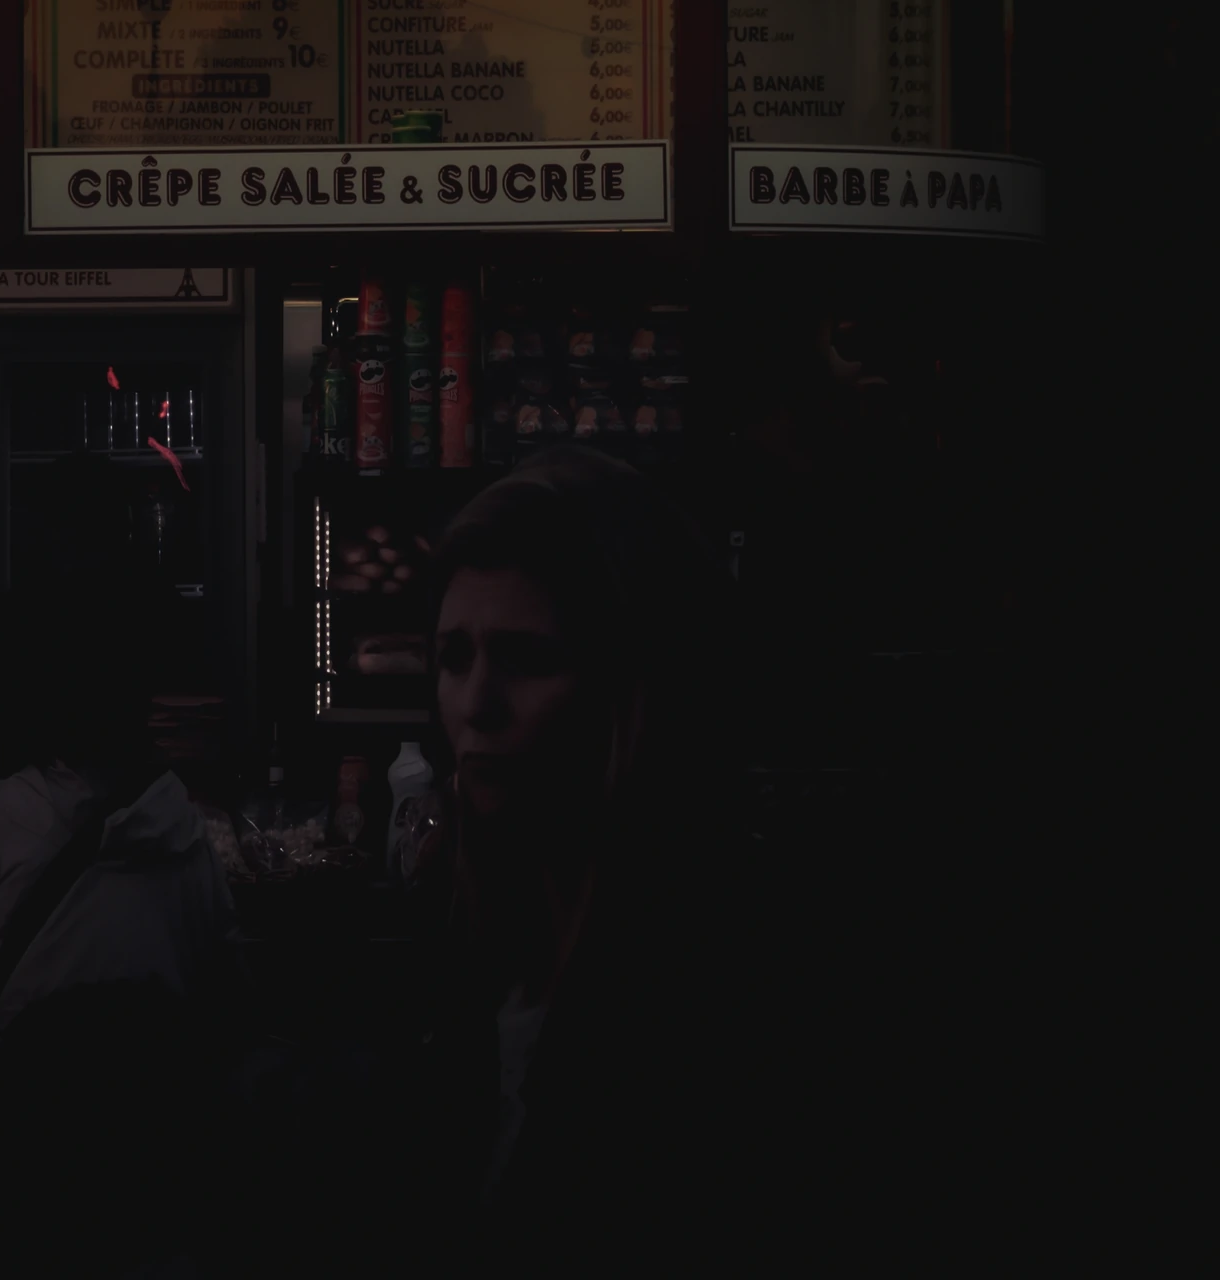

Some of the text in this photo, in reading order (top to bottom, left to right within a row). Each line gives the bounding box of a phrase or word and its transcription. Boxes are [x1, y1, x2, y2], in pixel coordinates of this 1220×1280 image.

[97, 20, 161, 40] MIXTE
[272, 16, 301, 41] 9€
[367, 16, 466, 33] CONFITURE
[590, 16, 633, 34] 5,00€
[73, 45, 185, 70] COMPLÈTE
[287, 43, 329, 68] 10€
[367, 39, 633, 57] NUTELLA 5,00€
[367, 61, 633, 80] NUTELLA BANANE 6,00€
[753, 75, 825, 92] BANANE
[367, 84, 633, 103] NUTELLA COCO 6,00€
[92, 100, 165, 114] FROMAGE
[179, 100, 242, 114] JAMBON
[259, 100, 313, 114] POULET
[753, 101, 846, 117] CHANTILLY
[120, 118, 224, 132] CHAMPIGNON
[240, 117, 301, 131] OIGNON
[306, 117, 335, 131] FRIT
[589, 108, 633, 126] 6,00€
[68, 148, 626, 208] CRÊPE SALÉE & SUCRÉE
[749, 166, 1003, 212] BARBE À PAPA
[13, 270, 61, 286] TOUR
[64, 270, 112, 286] EIFFEL
